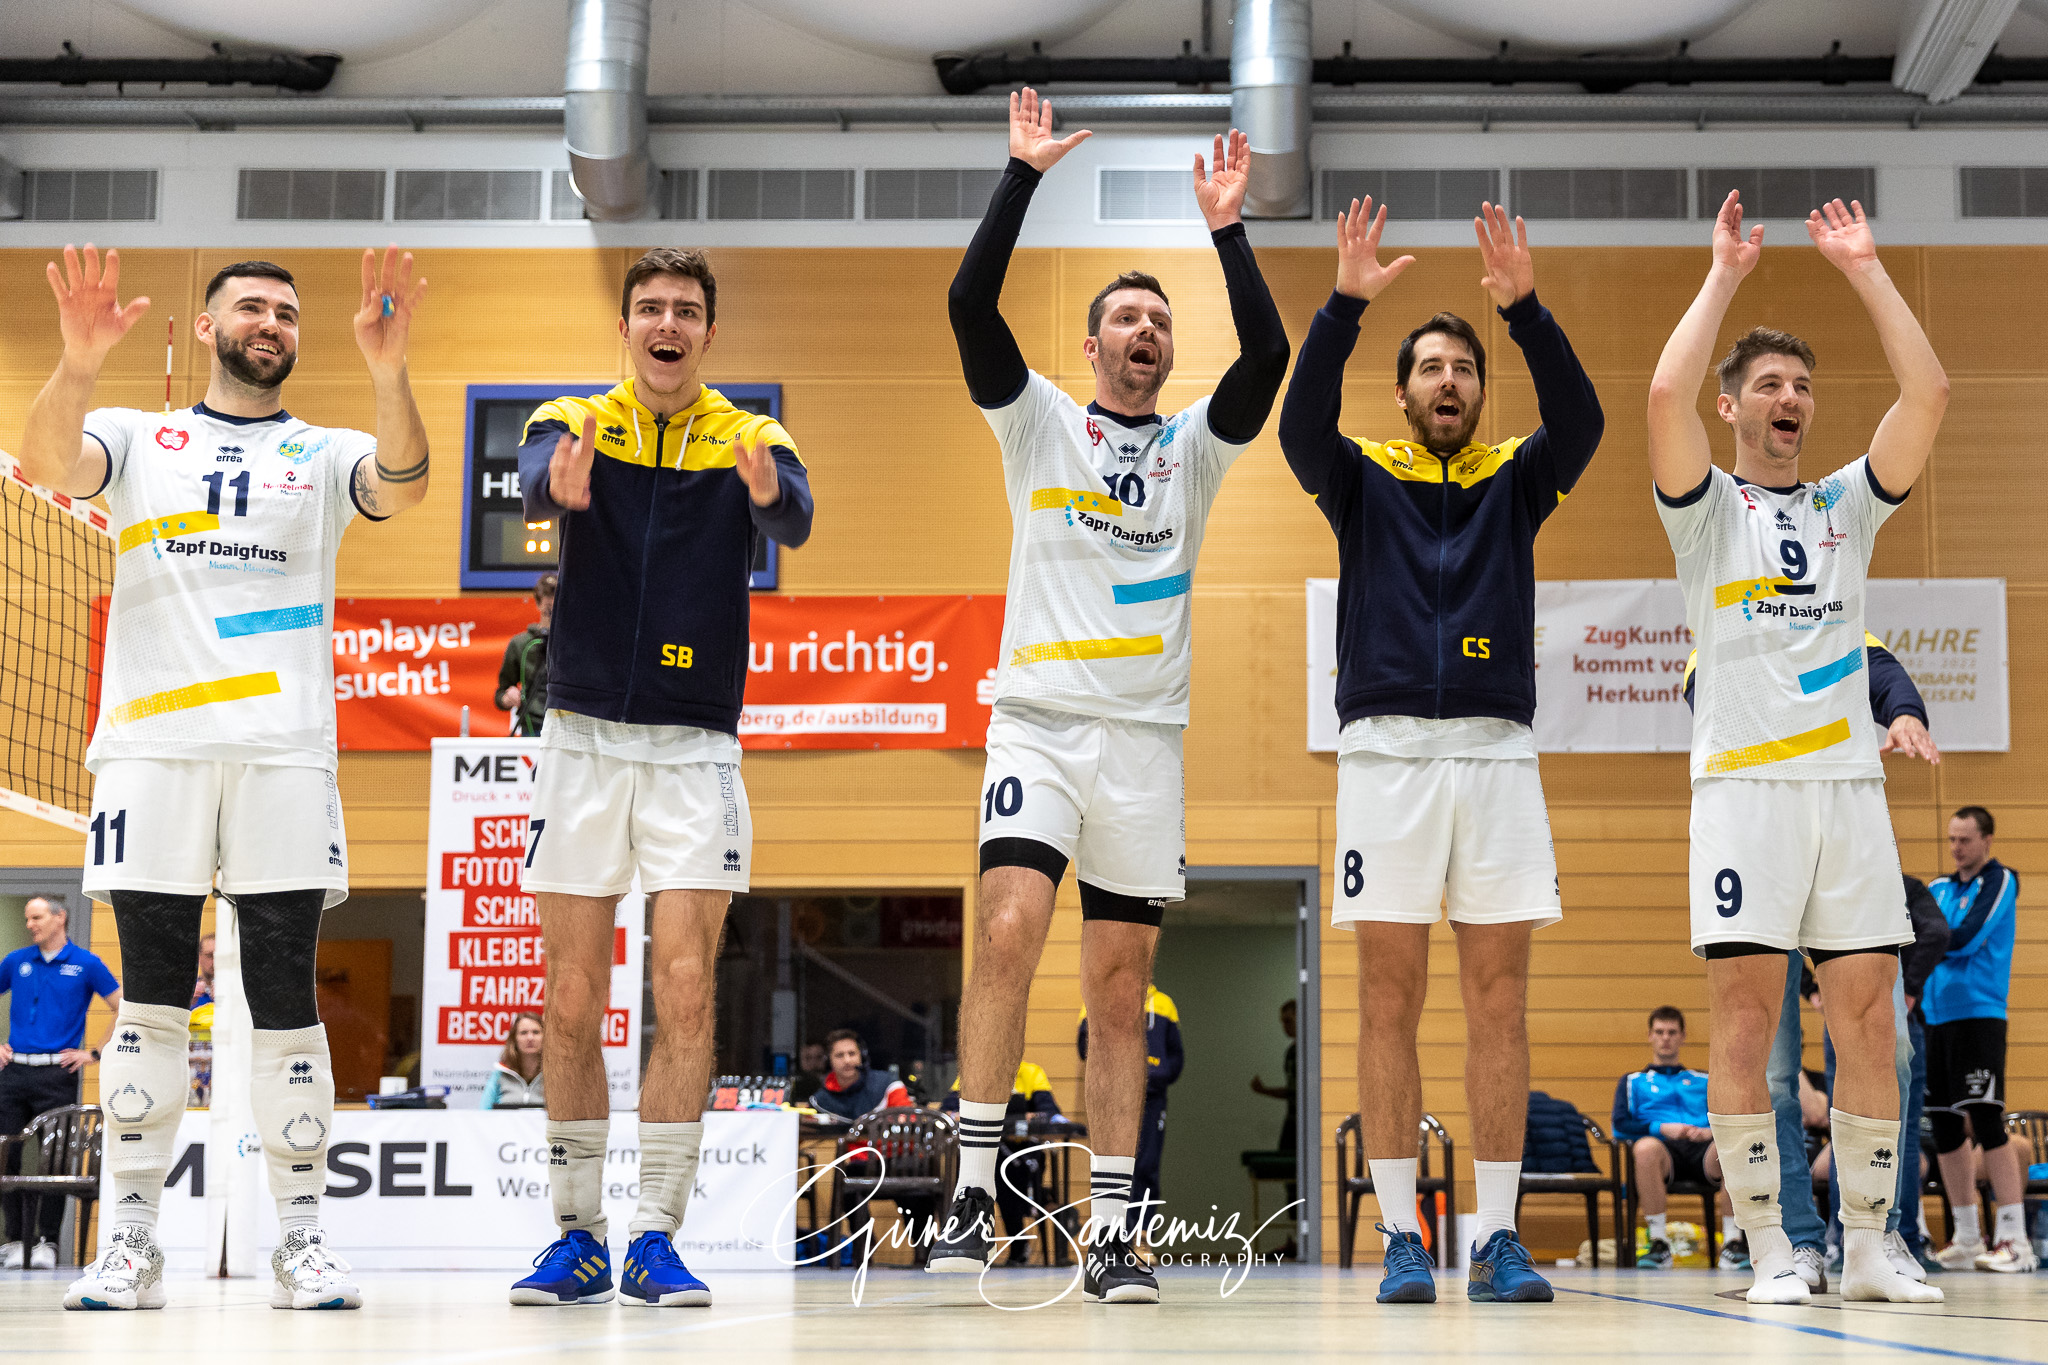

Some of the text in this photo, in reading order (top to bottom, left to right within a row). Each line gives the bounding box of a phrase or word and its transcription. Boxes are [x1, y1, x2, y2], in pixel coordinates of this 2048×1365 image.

[216, 455, 243, 463] errea
[201, 470, 250, 517] 11
[1103, 472, 1146, 508] 10
[1078, 511, 1110, 532] Zapf
[1112, 525, 1173, 545] Daigfuss
[166, 539, 287, 562] Zapf Daigfuss
[1780, 539, 1808, 581] 9
[1756, 600, 1843, 621] Zapf Daigfuss
[332, 618, 476, 662] mplayer
[1463, 637, 1490, 659] CS
[1584, 624, 1692, 650] ZugKunft
[661, 643, 693, 669] SB
[789, 630, 949, 683] richtig.
[1572, 653, 1687, 674] kommt vo
[334, 660, 451, 700] sucht!
[1587, 683, 1684, 703] Herkunf
[740, 702, 940, 730] berg.de/ausbildung
[454, 755, 538, 782] MEY
[985, 775, 1024, 824] 10
[90, 809, 127, 866] 11
[480, 818, 527, 850] SCH
[524, 818, 546, 869] 7
[452, 857, 525, 887] FOTOT
[1343, 849, 1365, 898] 8
[1714, 868, 1743, 918] 9
[474, 896, 540, 926] SCHR
[469, 975, 545, 1006] FAHRZ
[117, 1044, 140, 1053] errea
[289, 1074, 313, 1084] errea
[1870, 1160, 1891, 1169] errea
